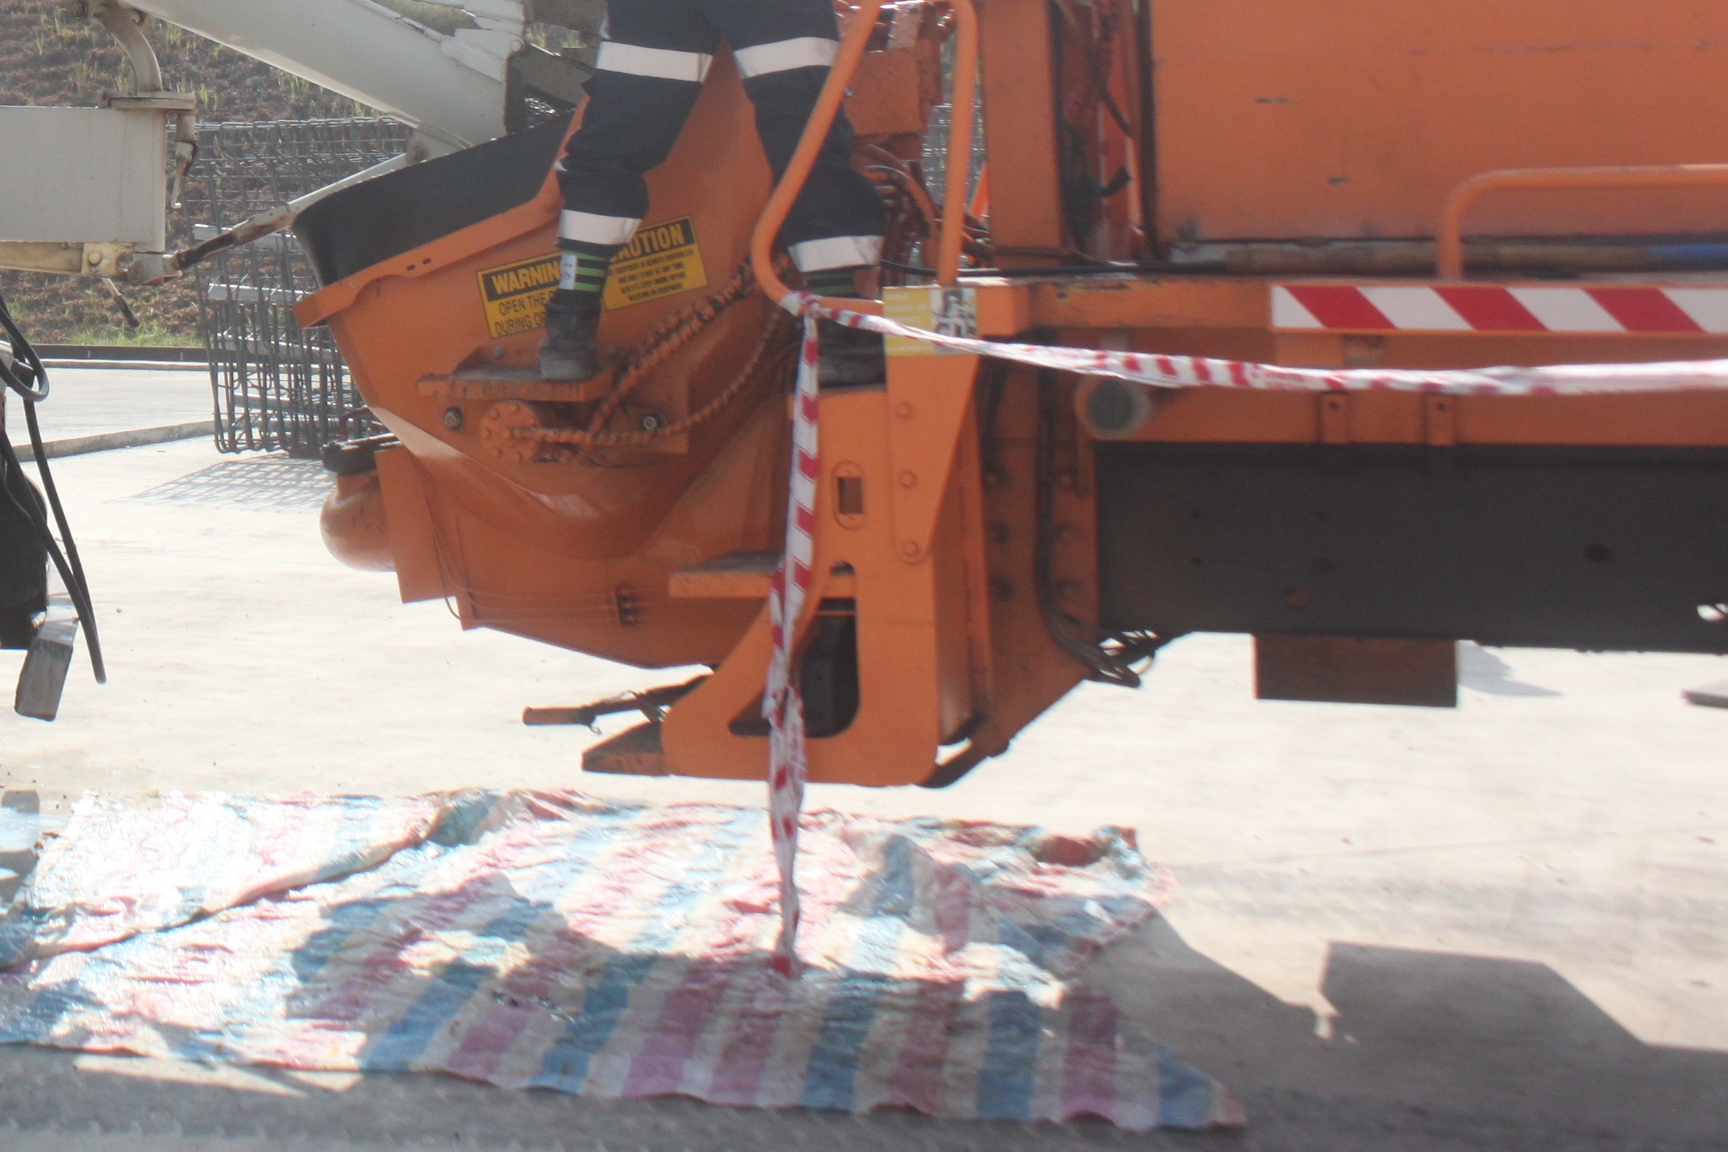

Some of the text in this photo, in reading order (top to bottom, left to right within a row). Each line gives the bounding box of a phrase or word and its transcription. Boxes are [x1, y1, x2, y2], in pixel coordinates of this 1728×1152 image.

[609, 223, 686, 263] AUTION
[491, 260, 562, 295] WARNIN
[498, 298, 527, 316] OPEN
[526, 292, 546, 309] THE
[494, 315, 533, 335] DURING
